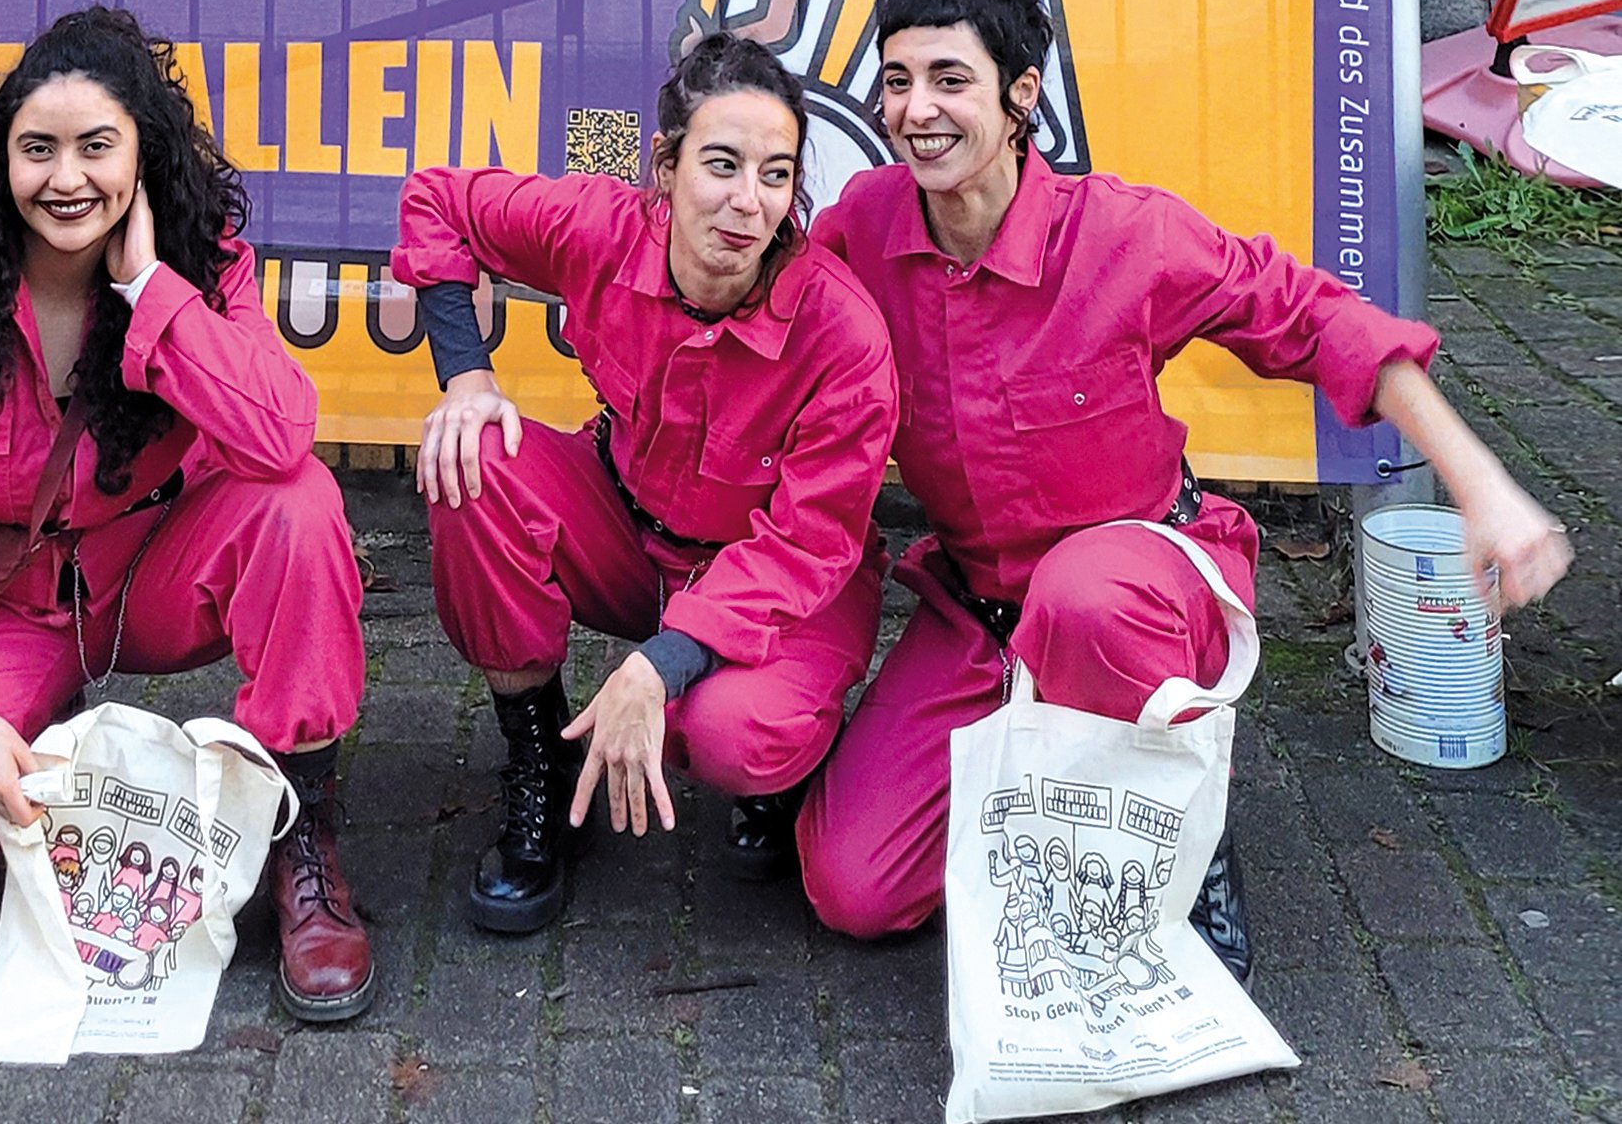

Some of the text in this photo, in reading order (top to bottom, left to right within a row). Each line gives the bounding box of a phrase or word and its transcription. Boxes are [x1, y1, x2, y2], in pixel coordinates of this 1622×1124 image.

[1339, 26, 1370, 85] des
[1339, 98, 1371, 296] Zusammen
[1004, 1004, 1040, 1022] Stop
